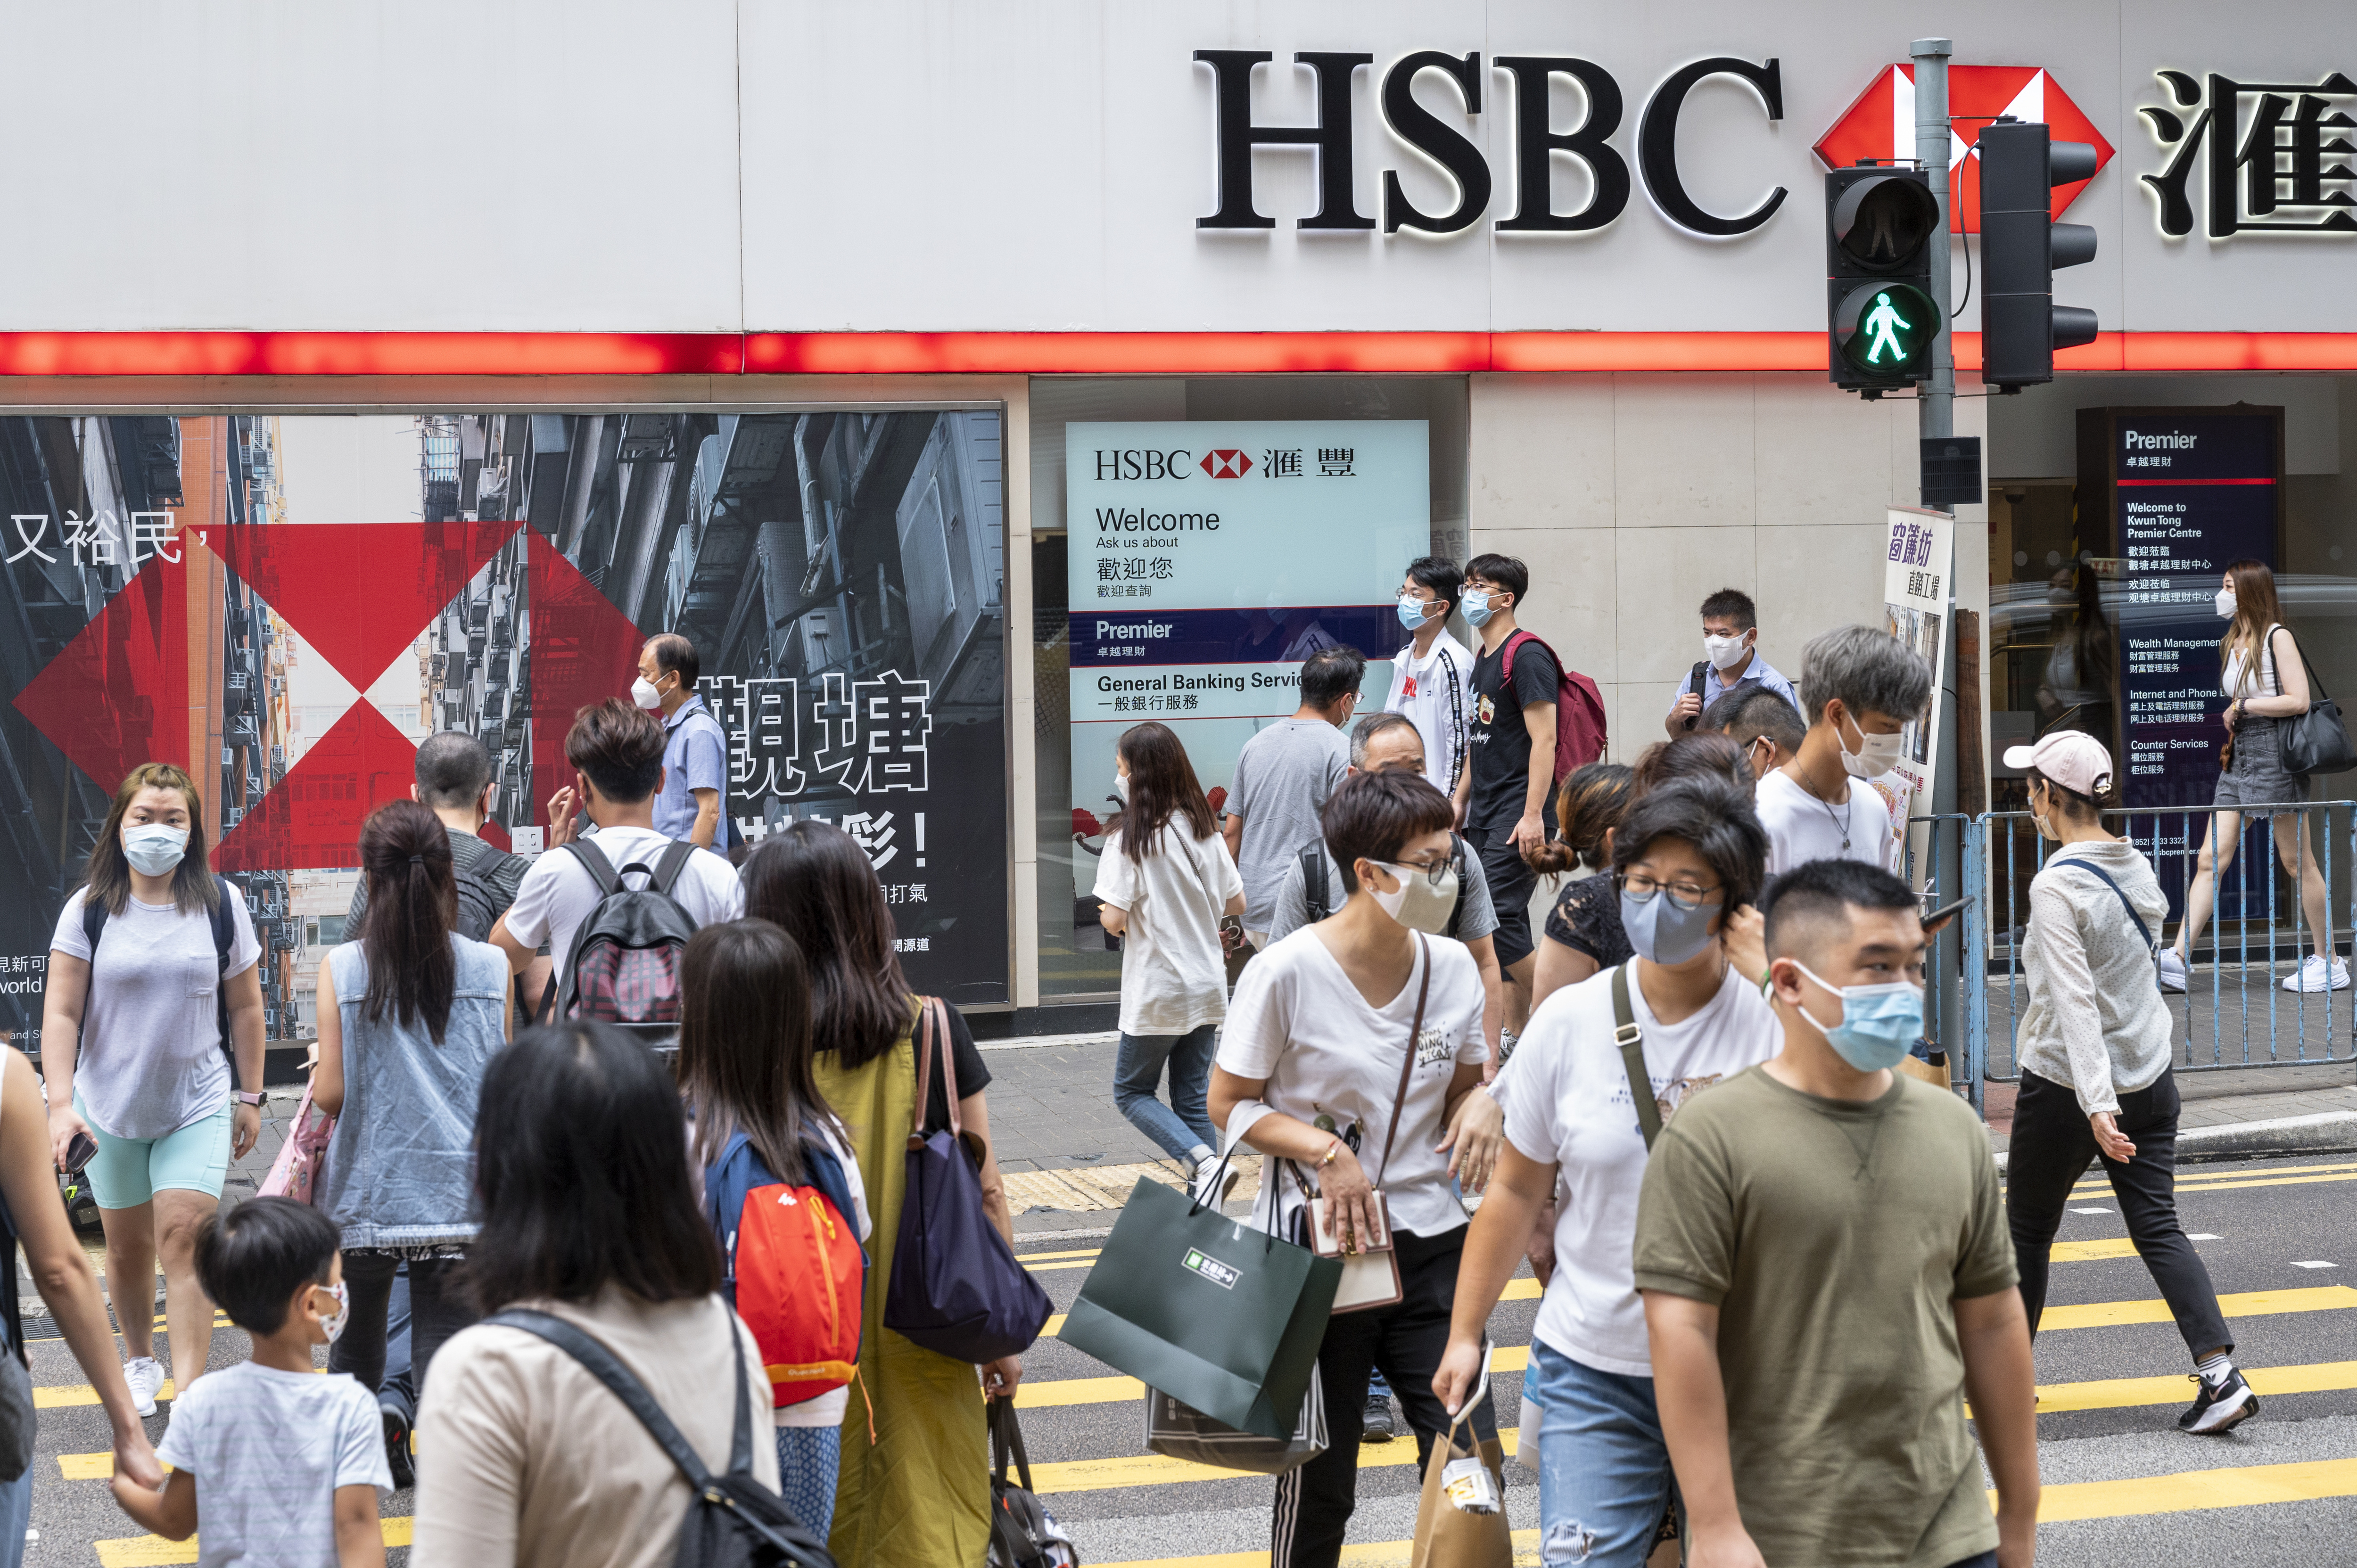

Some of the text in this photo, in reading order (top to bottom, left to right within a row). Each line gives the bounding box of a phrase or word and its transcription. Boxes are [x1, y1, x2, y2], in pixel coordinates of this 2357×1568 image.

[1193, 50, 1788, 235] HSBC
[2126, 431, 2197, 449] Premier
[1094, 450, 1191, 480] HSBC
[2127, 456, 2171, 467] 卓越理財
[2127, 503, 2186, 512] Welcome to
[1096, 508, 1219, 531] Welcome
[2128, 516, 2181, 526] Kwun Tong
[2128, 528, 2201, 538] Premier Centre
[1096, 536, 1178, 548] Ask us about
[2128, 546, 2169, 557] 歡迎蒞臨
[1097, 557, 1173, 581] 歡迎您
[2128, 559, 2211, 570] 觀塘卓越理財中心
[1907, 570, 1939, 600] 直銷工場
[2129, 579, 2169, 589] 欢迎莅临
[1097, 584, 1151, 598] 歡迎查詢
[2129, 592, 2212, 603] 观塘卓越理财中心
[1097, 620, 1172, 639] Premier
[2129, 639, 2220, 649] Wealth Managemen
[1097, 646, 1145, 657] 卓越理財
[2130, 651, 2179, 660] 財富管理服務
[2130, 664, 2179, 673] 财富管理服务
[1098, 671, 1302, 691] General Banking Servic
[2131, 690, 2166, 699] Internet
[2168, 689, 2185, 698] and
[2189, 689, 2217, 697] Phone
[1098, 694, 1198, 711] 一般銀行服務
[2130, 701, 2204, 711] 網上及電話理財服務
[2131, 714, 2205, 724] 网上及电话理财服务
[2131, 739, 2208, 749] Counter Services
[2131, 753, 2164, 762] 櫃位服務
[2131, 765, 2164, 774] 柜位服务
[10, 1030, 28, 1039] and
